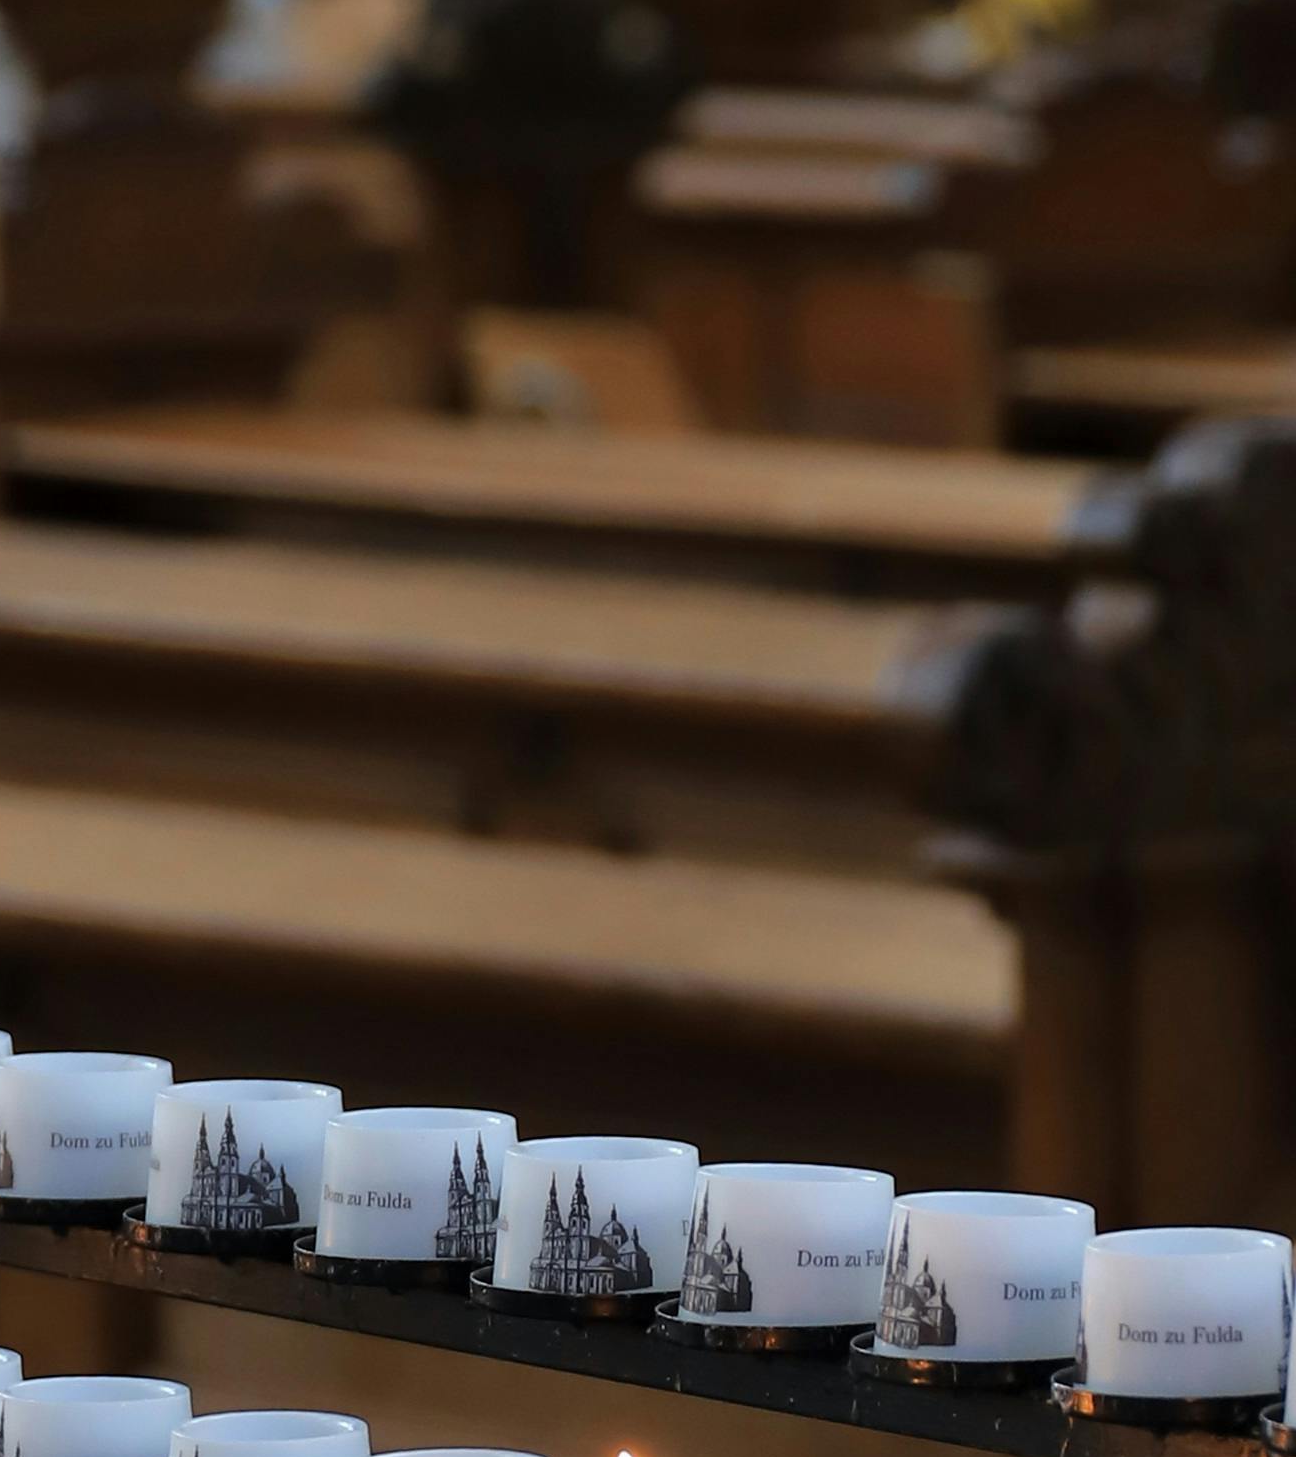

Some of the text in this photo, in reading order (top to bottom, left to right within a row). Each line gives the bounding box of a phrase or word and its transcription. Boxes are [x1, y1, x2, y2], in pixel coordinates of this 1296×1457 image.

[50, 1132, 90, 1150] Dom
[95, 1136, 114, 1149] zu
[347, 1193, 362, 1206] zu
[367, 1190, 412, 1210] Fulda
[797, 1249, 839, 1268] Dom
[845, 1253, 863, 1268] zu
[1004, 1283, 1045, 1302] Dom
[1050, 1287, 1067, 1301] zu
[1117, 1323, 1244, 1344] Dom zu Fulda
